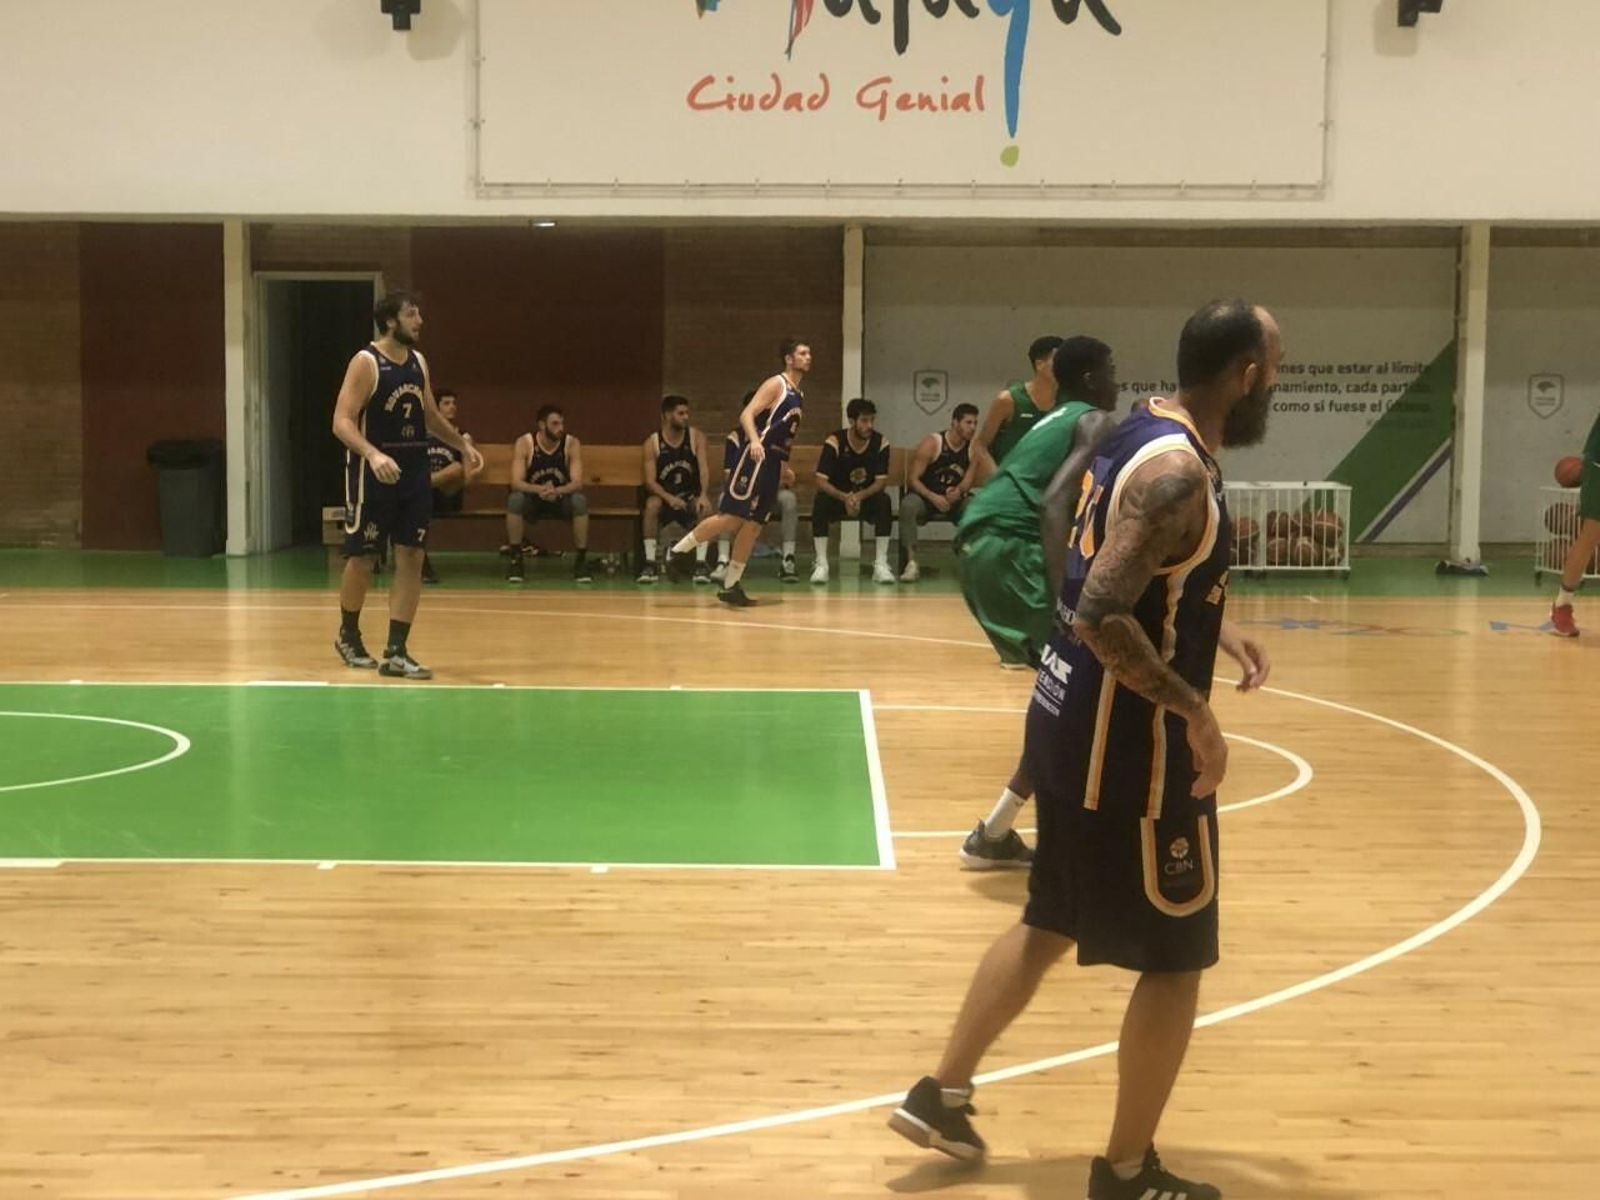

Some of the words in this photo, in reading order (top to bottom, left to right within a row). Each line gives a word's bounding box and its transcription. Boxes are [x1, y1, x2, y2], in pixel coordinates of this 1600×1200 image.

[686, 72, 830, 112] Ciudad
[855, 75, 985, 121] Genial
[1308, 364, 1334, 377] que
[1337, 363, 1373, 375] estar
[1376, 361, 1388, 375] al
[1131, 382, 1157, 395] que
[1346, 381, 1378, 394] cada
[402, 403, 412, 419] 7
[1273, 401, 1310, 413] como
[1329, 399, 1366, 413] fuese
[1370, 399, 1382, 413] el
[416, 528, 426, 542] 7
